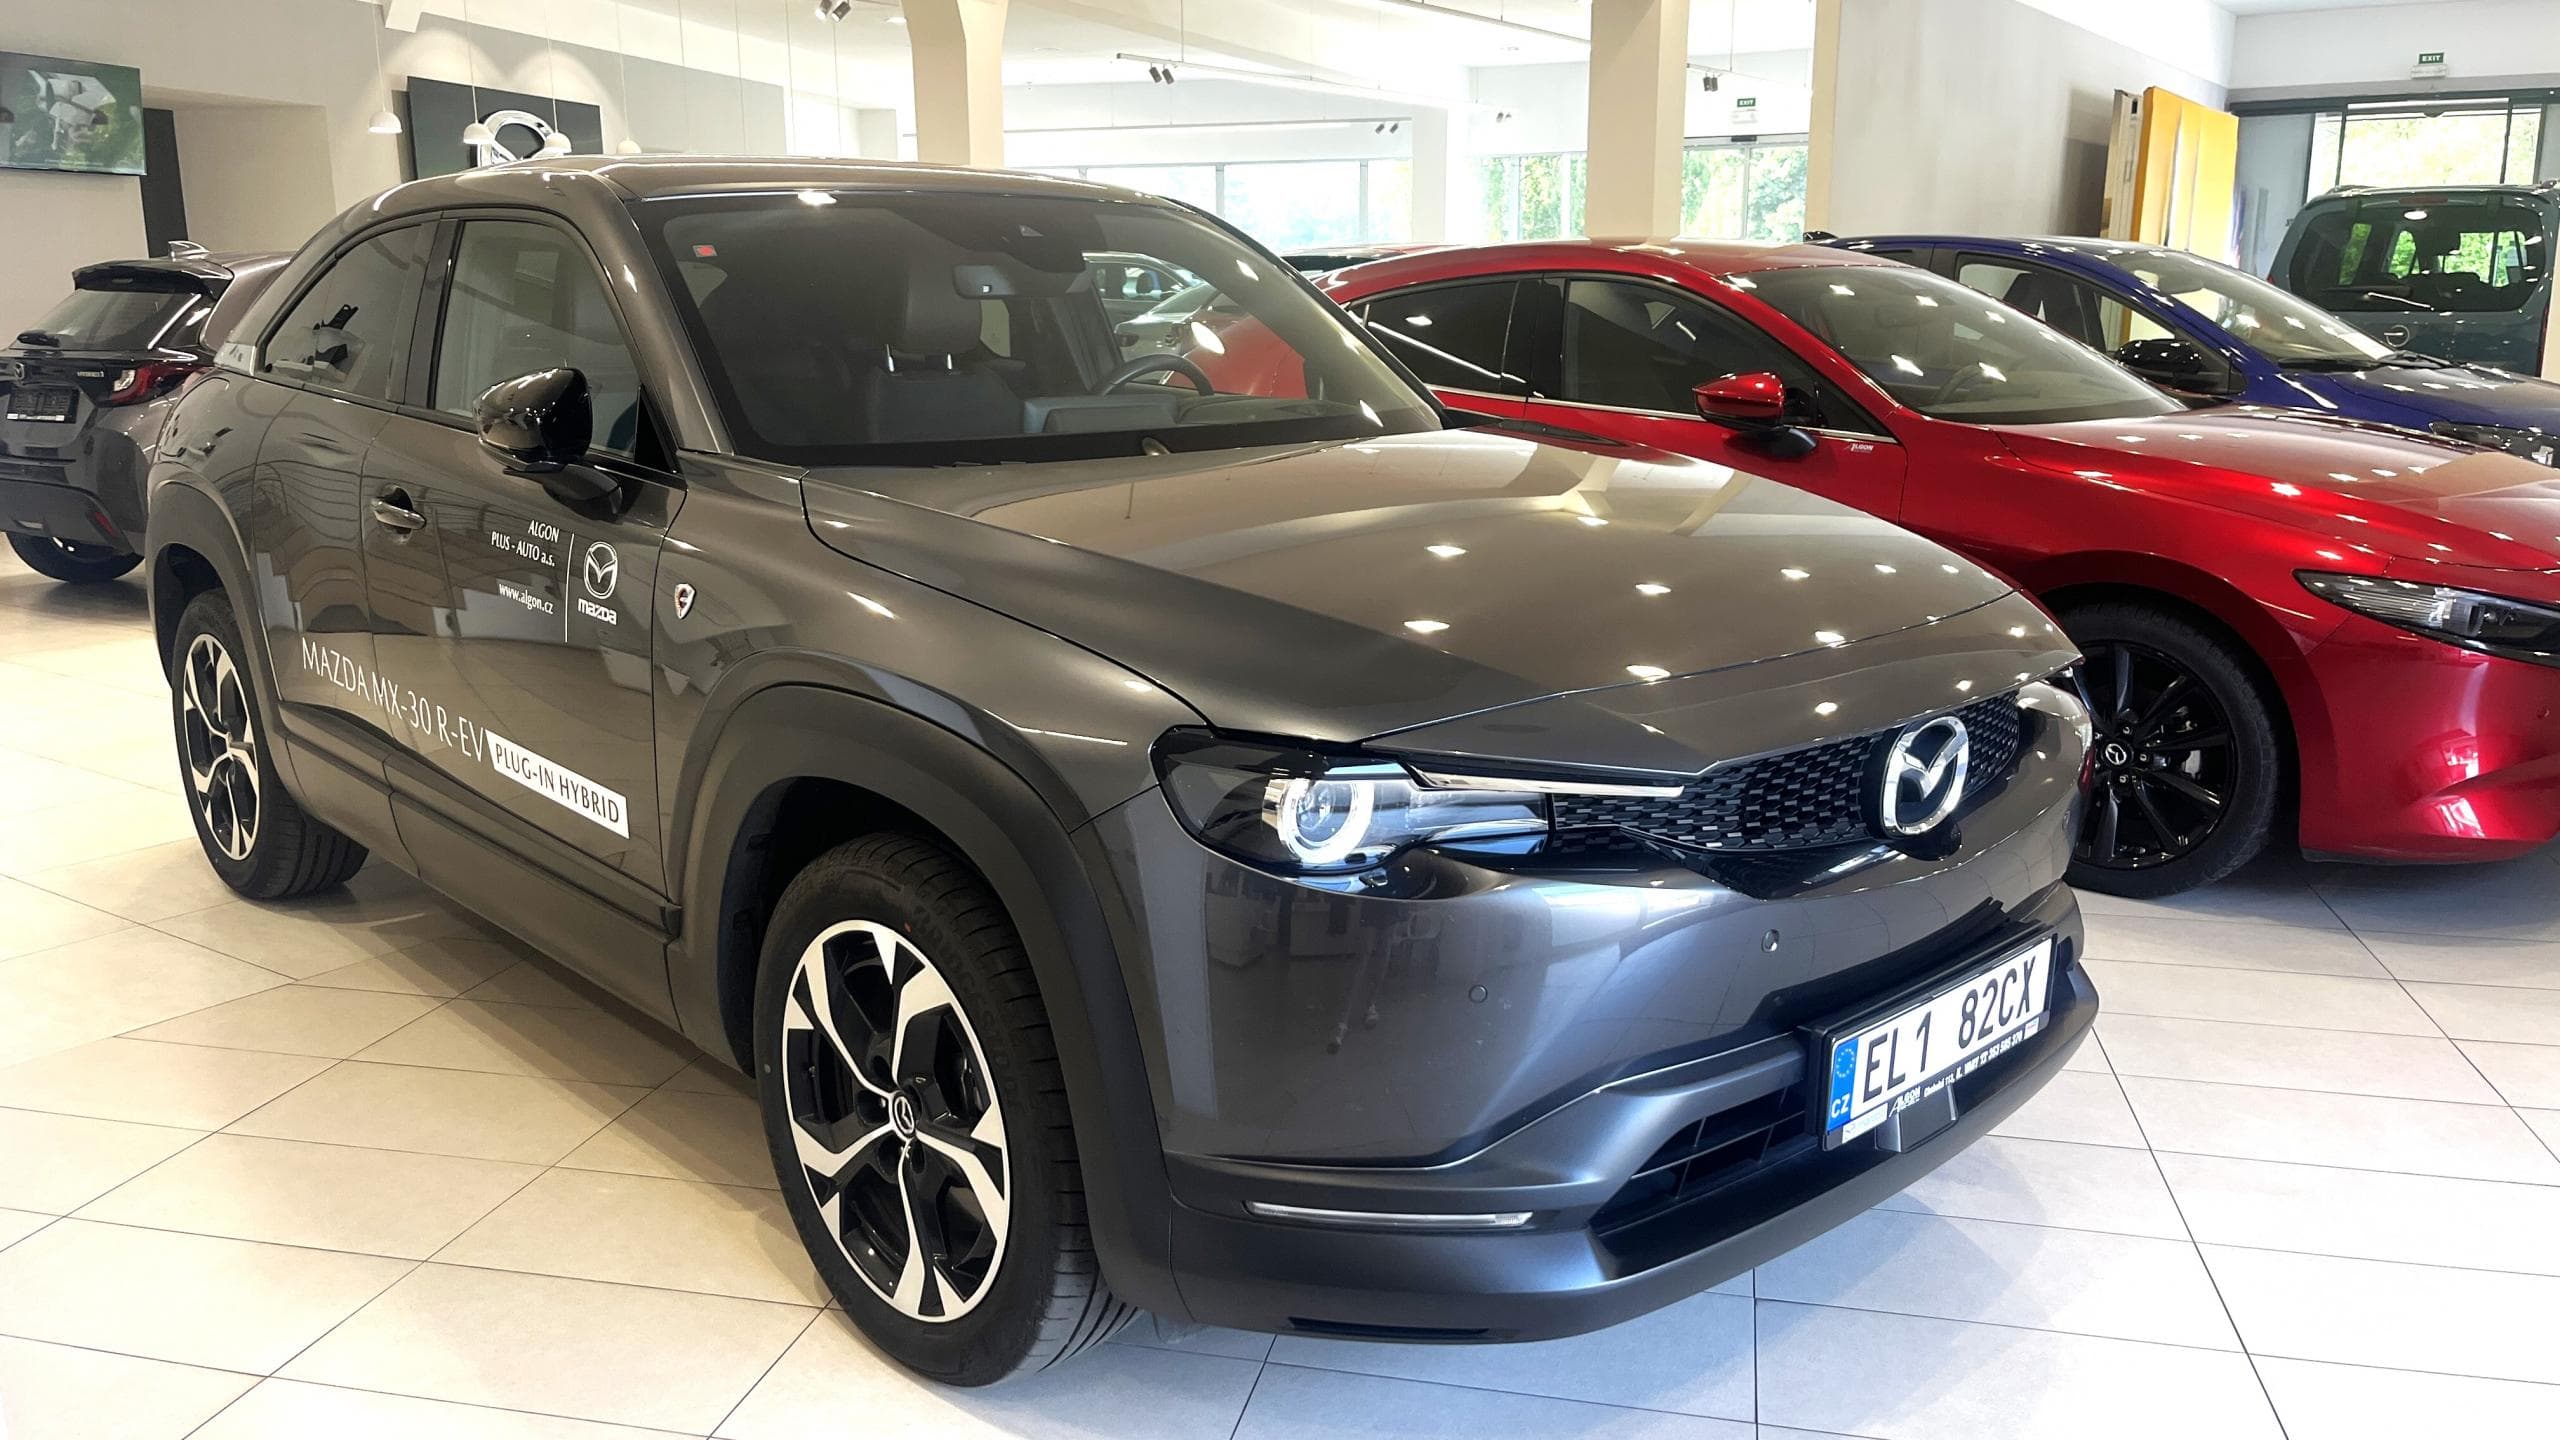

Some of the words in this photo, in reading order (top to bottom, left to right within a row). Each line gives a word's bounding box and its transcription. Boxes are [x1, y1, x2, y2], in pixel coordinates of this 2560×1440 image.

[491, 531, 510, 551] PLUS
[516, 540, 540, 561] AUTO
[541, 550, 556, 567] a.s.
[527, 519, 560, 544] ALGON
[499, 583, 554, 615] www.algon.cz
[302, 637, 370, 701] MAZDA
[372, 671, 432, 735] MX-30
[436, 705, 486, 763] R-EV
[495, 743, 555, 789] PLUG-IN
[559, 774, 620, 824] HYBRID
[1958, 955, 2036, 1050] 82CX
[1831, 1093, 1850, 1118] CZ
